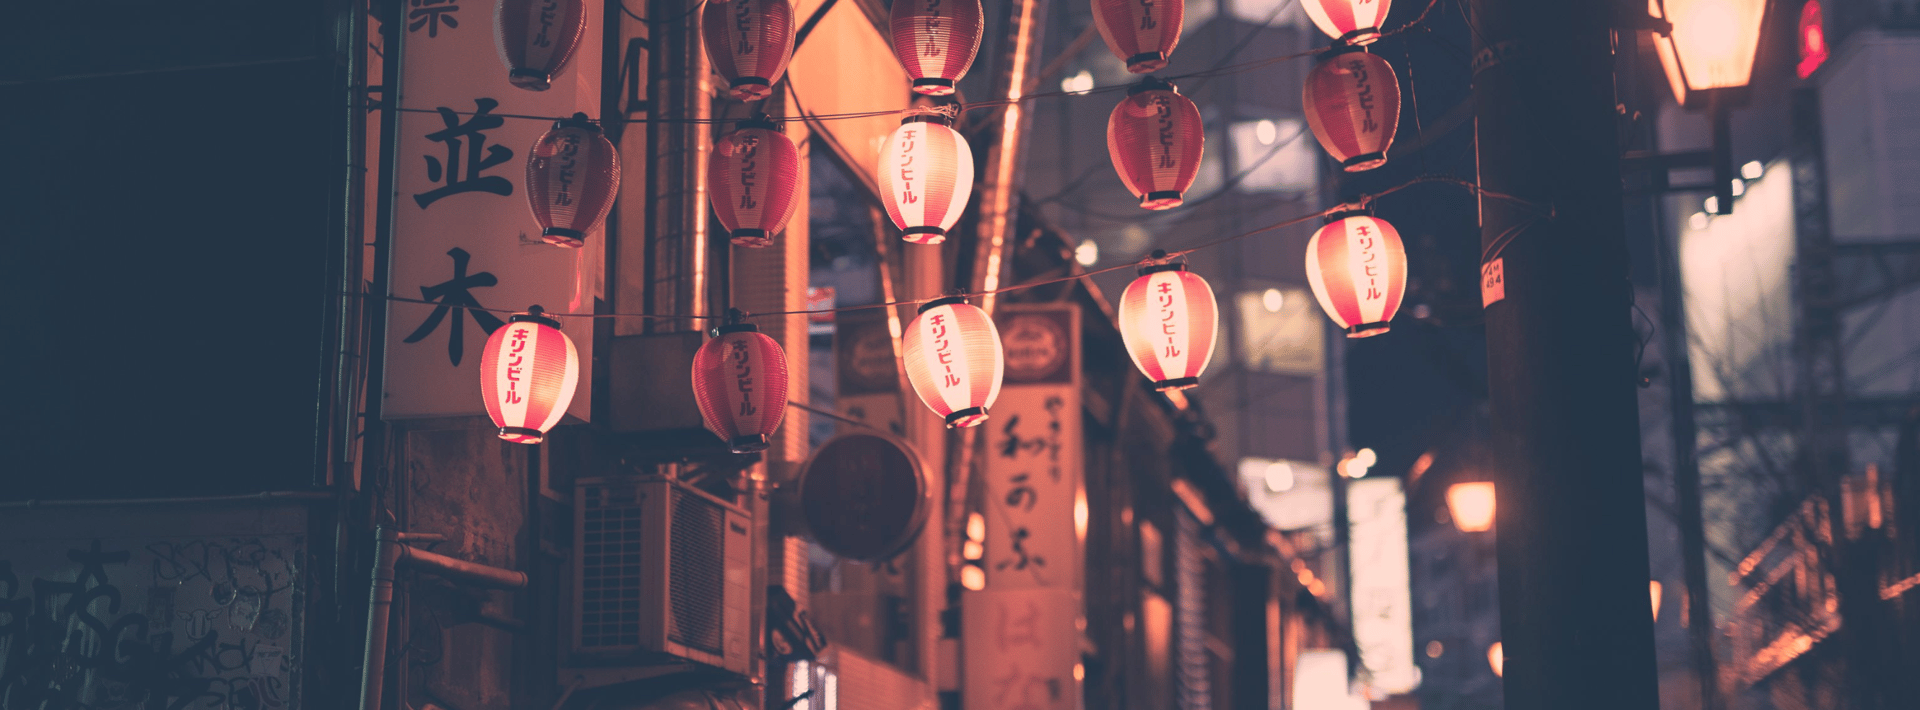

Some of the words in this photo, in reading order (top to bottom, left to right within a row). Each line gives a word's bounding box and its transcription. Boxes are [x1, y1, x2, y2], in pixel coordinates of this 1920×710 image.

[1153, 94, 1176, 170] キリンビール
[1349, 60, 1378, 134] キリンビール
[555, 134, 580, 208] キリンビール
[739, 135, 759, 210] キリンビール
[505, 329, 530, 405] キリンビール
[732, 340, 757, 417] キリンビール
[929, 314, 961, 389] キリンビール
